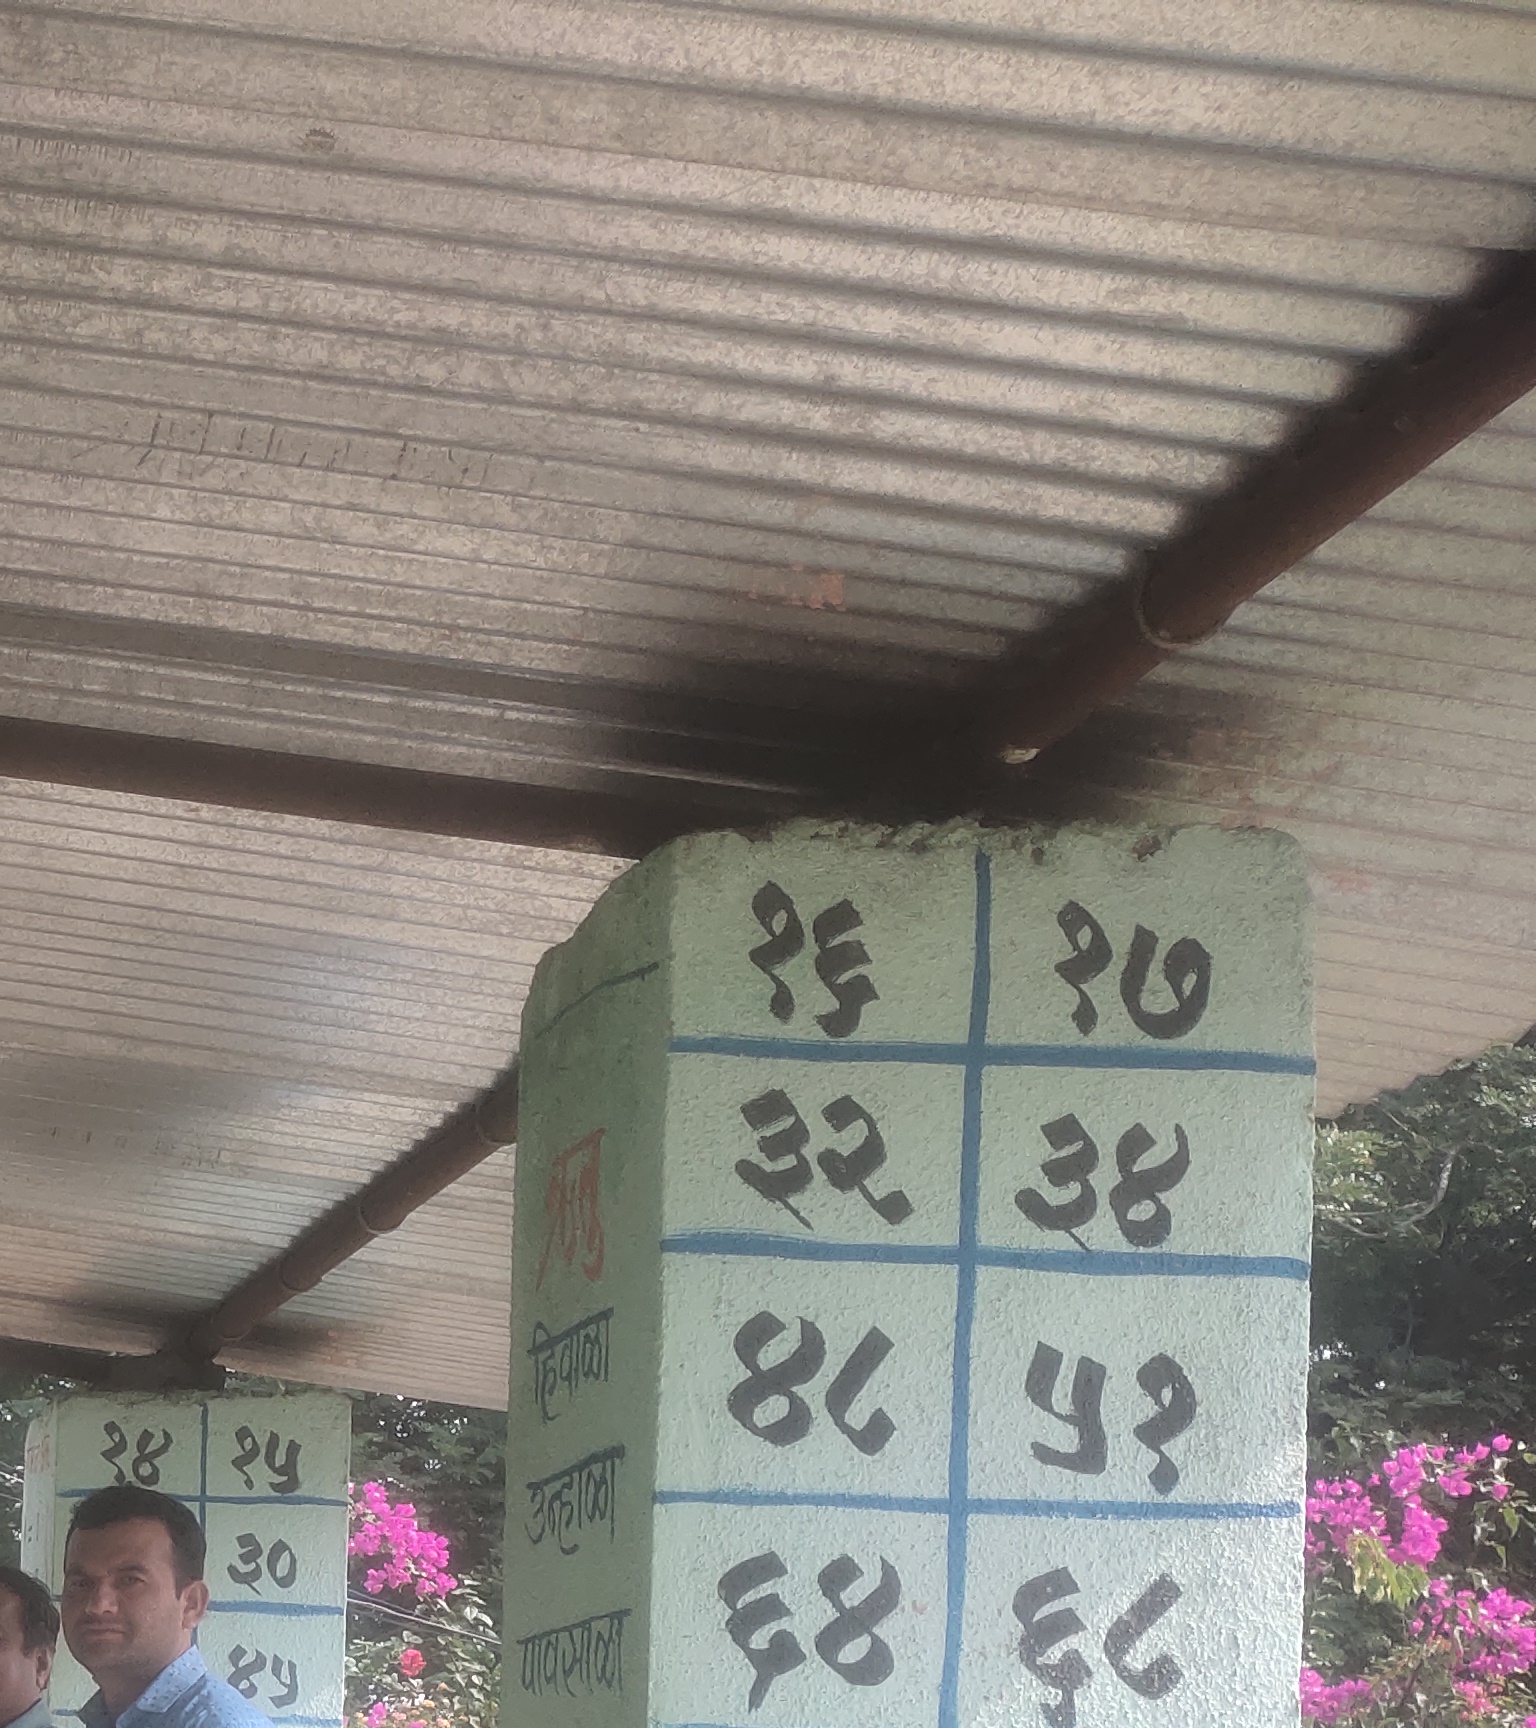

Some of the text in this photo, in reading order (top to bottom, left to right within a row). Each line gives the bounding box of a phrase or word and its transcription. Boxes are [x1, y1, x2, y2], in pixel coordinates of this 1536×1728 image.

[749, 880, 1213, 1039] १६ १७
[735, 1088, 1189, 1252] ३२ ३४
[527, 1307, 614, 1424] हिवाळा
[728, 1310, 1196, 1496] ४८ ५१
[101, 1420, 173, 1488] १४
[231, 1425, 302, 1494] १५
[525, 1444, 625, 1554] उन्हाळा
[226, 1532, 297, 1595] ३०
[229, 1644, 299, 1709] ४५
[516, 1608, 632, 1698] पावसाळा
[717, 1550, 901, 1713] ६४
